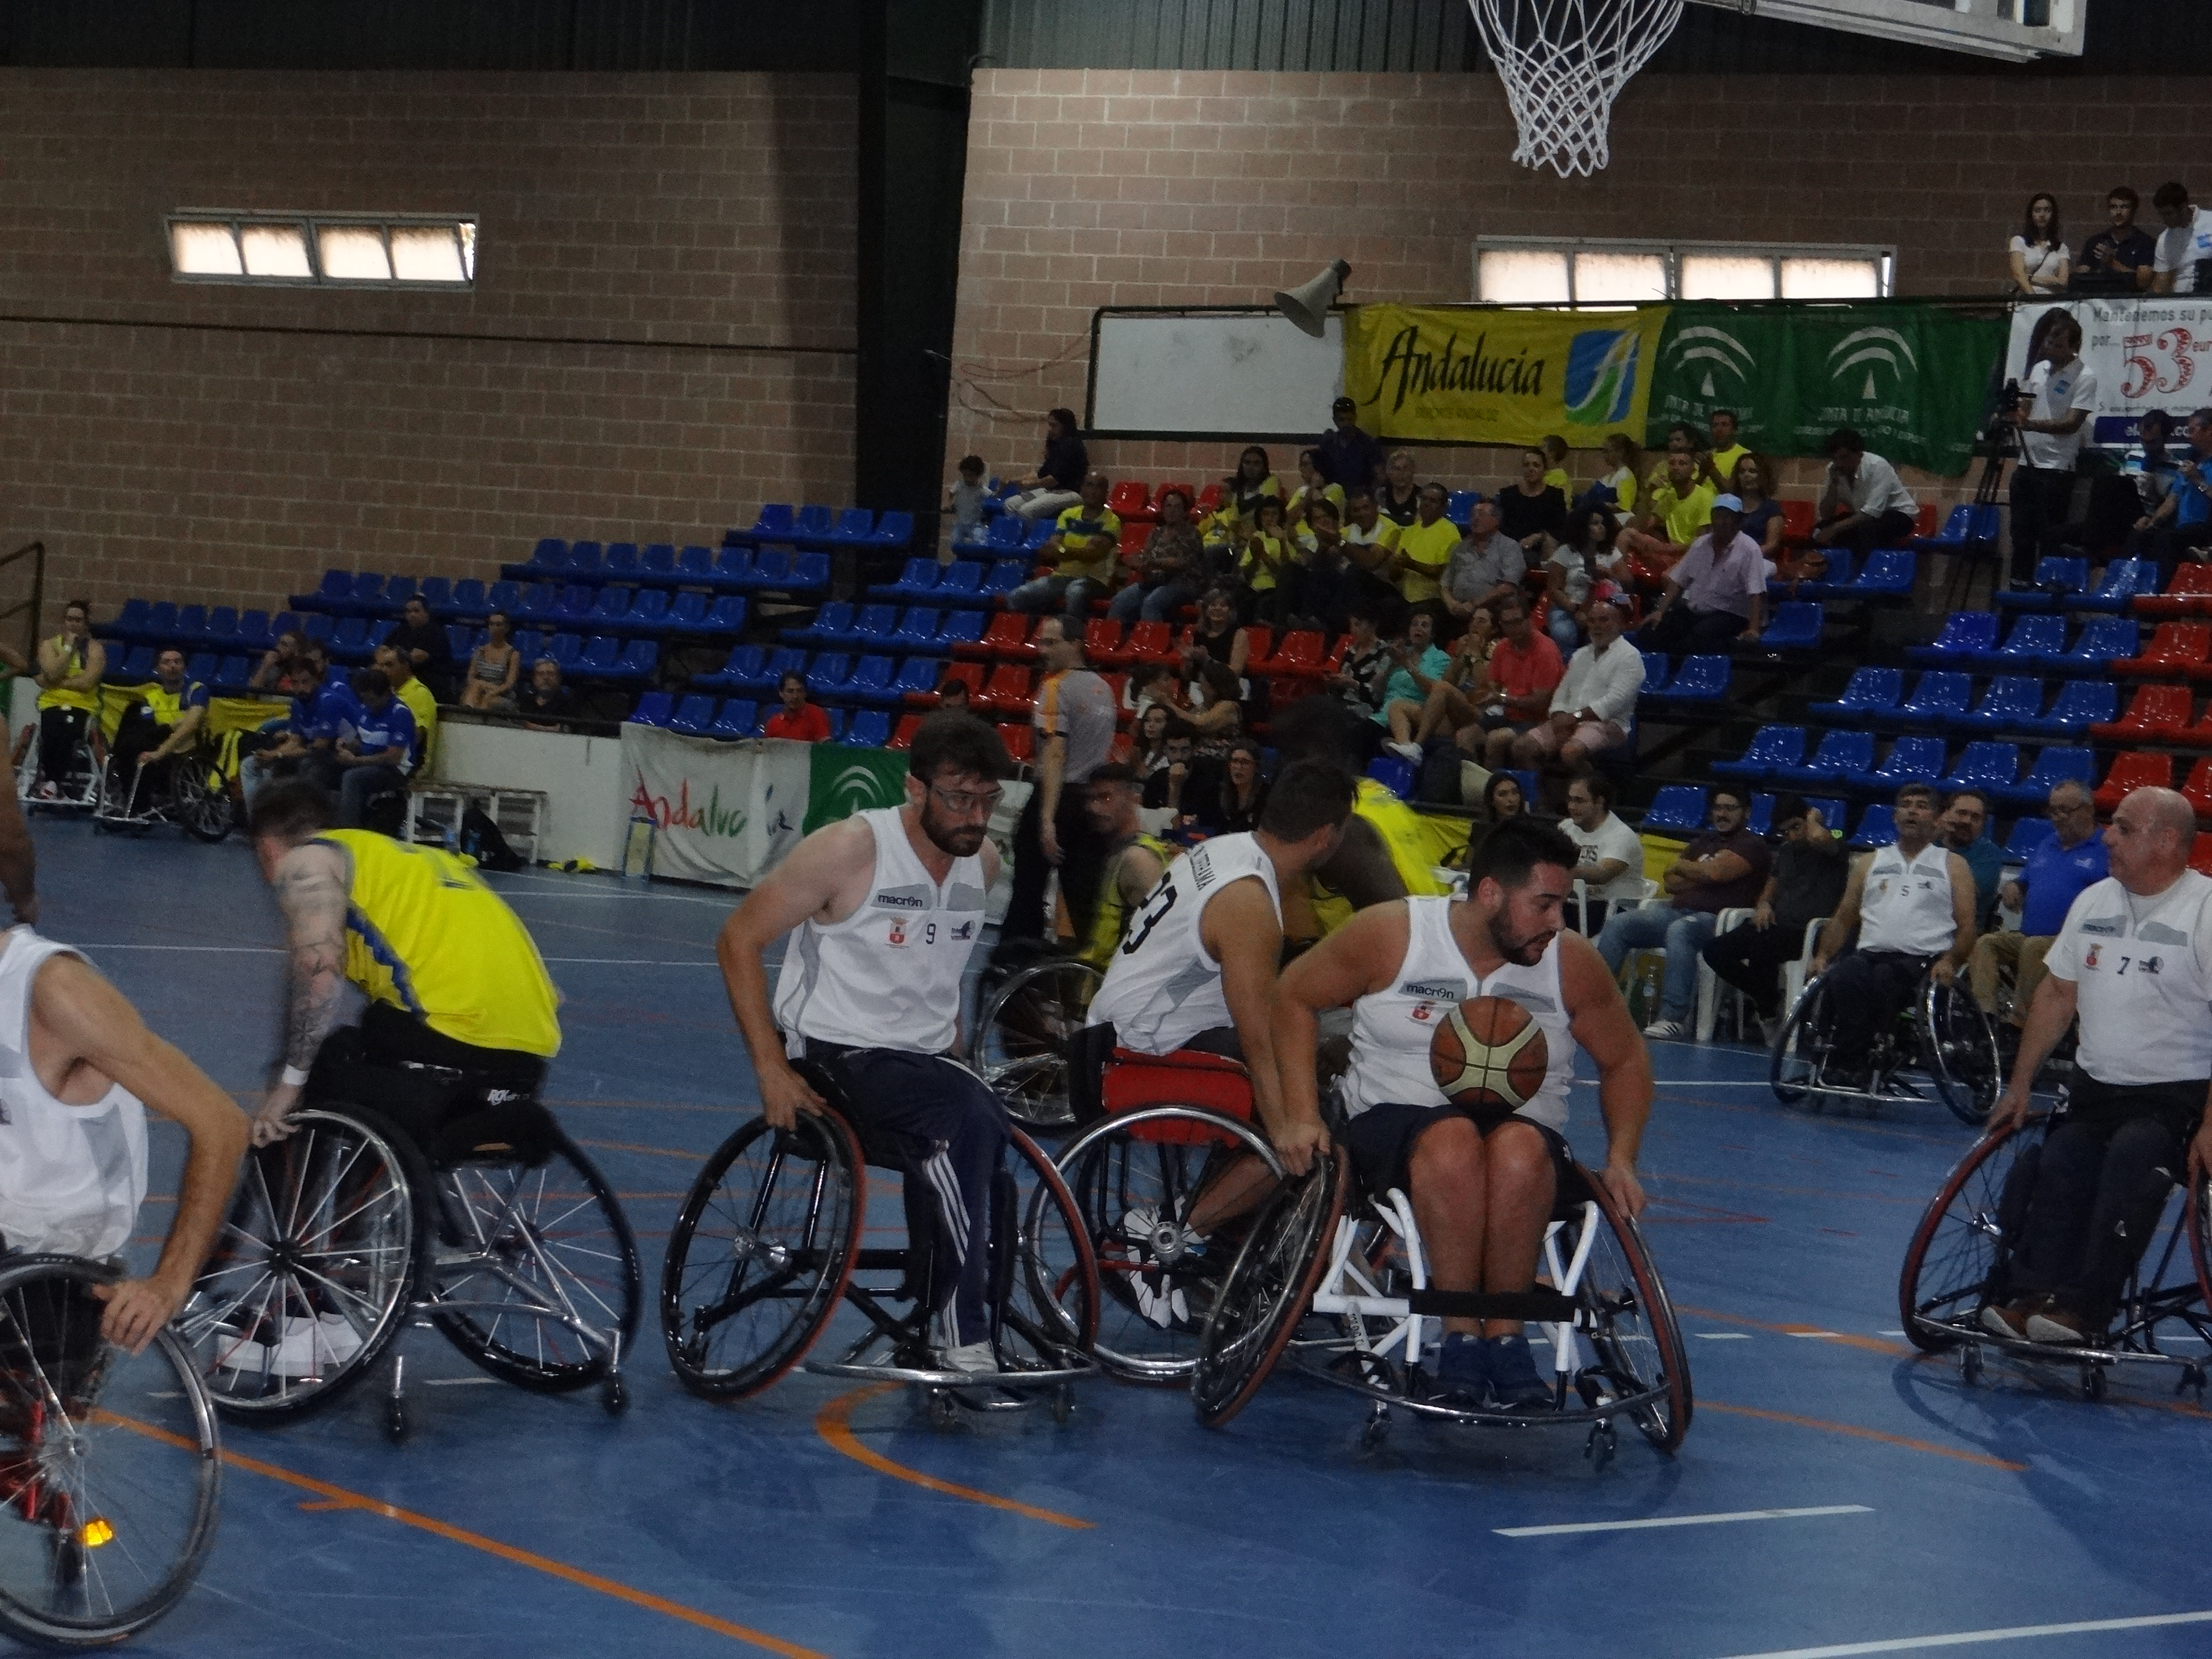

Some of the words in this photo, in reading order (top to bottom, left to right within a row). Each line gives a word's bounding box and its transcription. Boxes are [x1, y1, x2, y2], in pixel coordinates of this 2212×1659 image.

[2179, 310, 2195, 322] su
[2120, 327, 2195, 398] 53
[1900, 885, 1911, 897] 5
[878, 894, 923, 908] macron
[926, 923, 936, 945] 9
[2117, 956, 2131, 975] 7
[1406, 984, 1455, 999] macron
